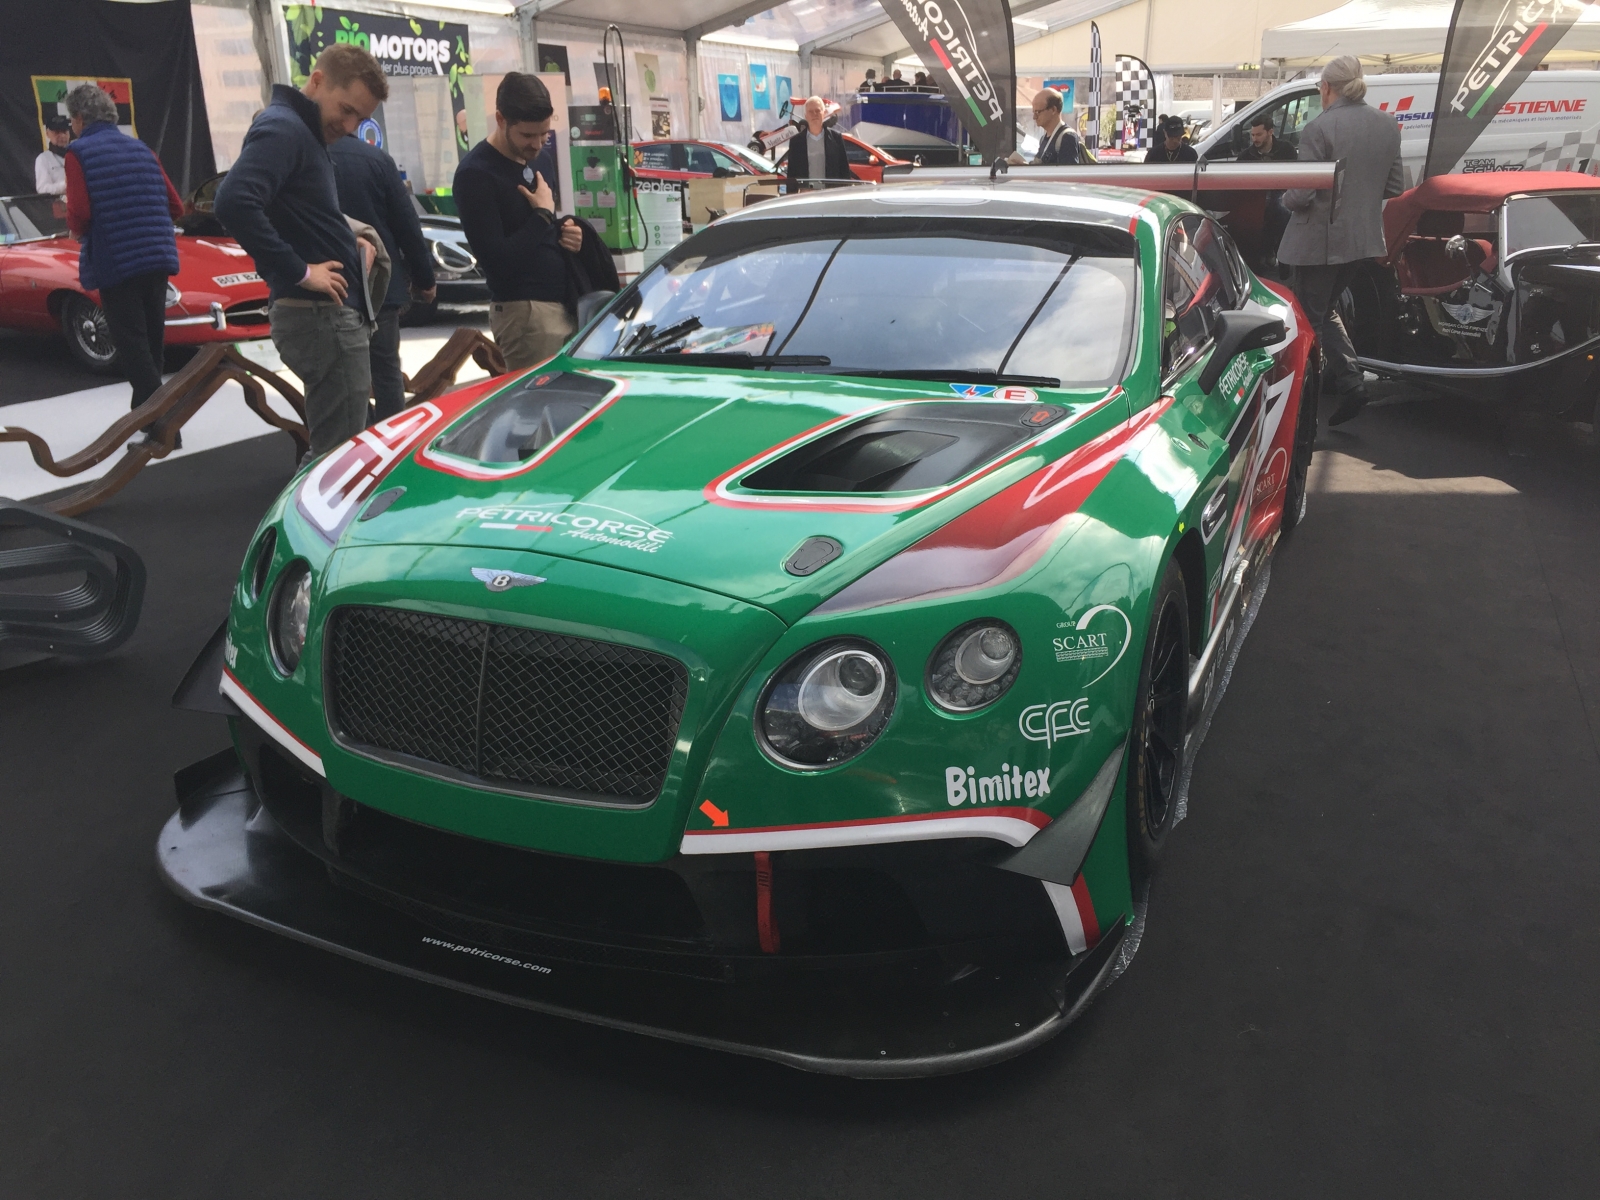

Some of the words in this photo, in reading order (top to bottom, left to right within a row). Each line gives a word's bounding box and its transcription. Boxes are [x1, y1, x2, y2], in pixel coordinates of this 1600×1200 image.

[1450, 0, 1547, 113] PETRIC
[393, 63, 409, 75] plus
[409, 65, 433, 76] propre
[1462, 165, 1525, 174] SCHATZ
[635, 178, 682, 193] zepter
[1256, 473, 1276, 496] SCART
[456, 507, 673, 544] PETRICORSE
[560, 527, 664, 553] Automobili
[1056, 621, 1076, 629] GROUP
[1053, 633, 1107, 652] SCART
[945, 763, 1051, 806] Bimitex
[422, 936, 552, 974] www.petricorse.com
